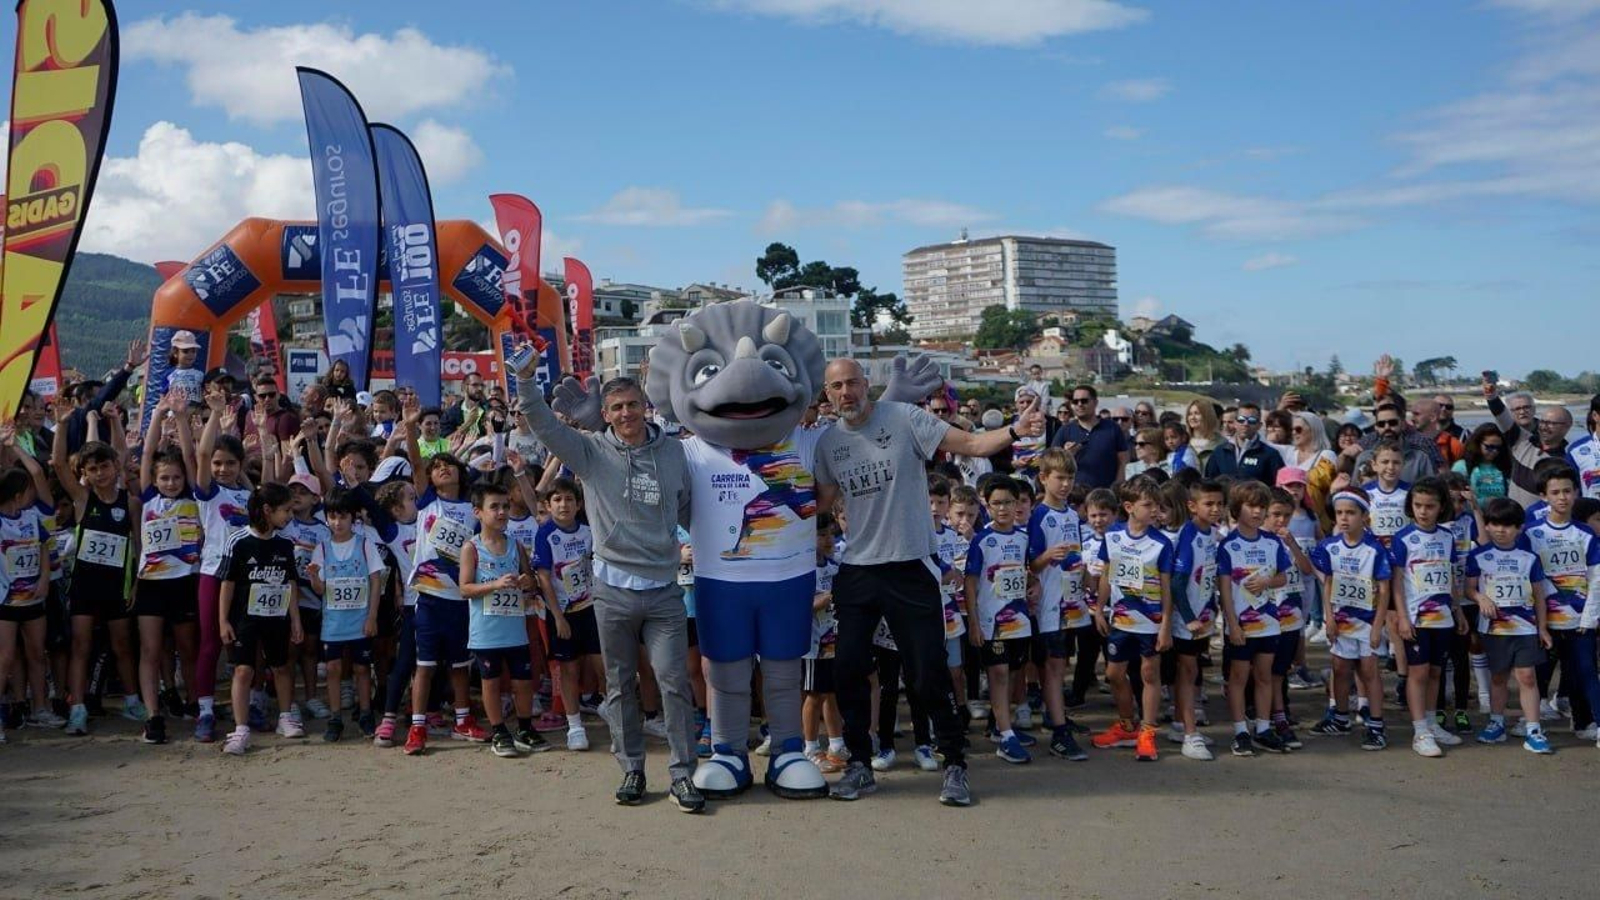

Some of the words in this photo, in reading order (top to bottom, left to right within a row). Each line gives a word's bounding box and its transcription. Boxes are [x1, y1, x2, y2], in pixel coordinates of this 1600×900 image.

[207, 260, 235, 284] FE
[214, 267, 248, 296] seguros
[711, 473, 750, 483] CARREIRA
[1377, 516, 1403, 528] 320
[436, 527, 465, 549] 383
[87, 540, 116, 557] 321
[1550, 550, 1579, 565] 470
[1117, 564, 1140, 580] 348
[1424, 571, 1448, 585] 475
[334, 587, 361, 602] 387
[1337, 584, 1366, 600] 328
[1495, 585, 1522, 598] 371
[257, 593, 282, 607] 461
[492, 593, 518, 607] 322
